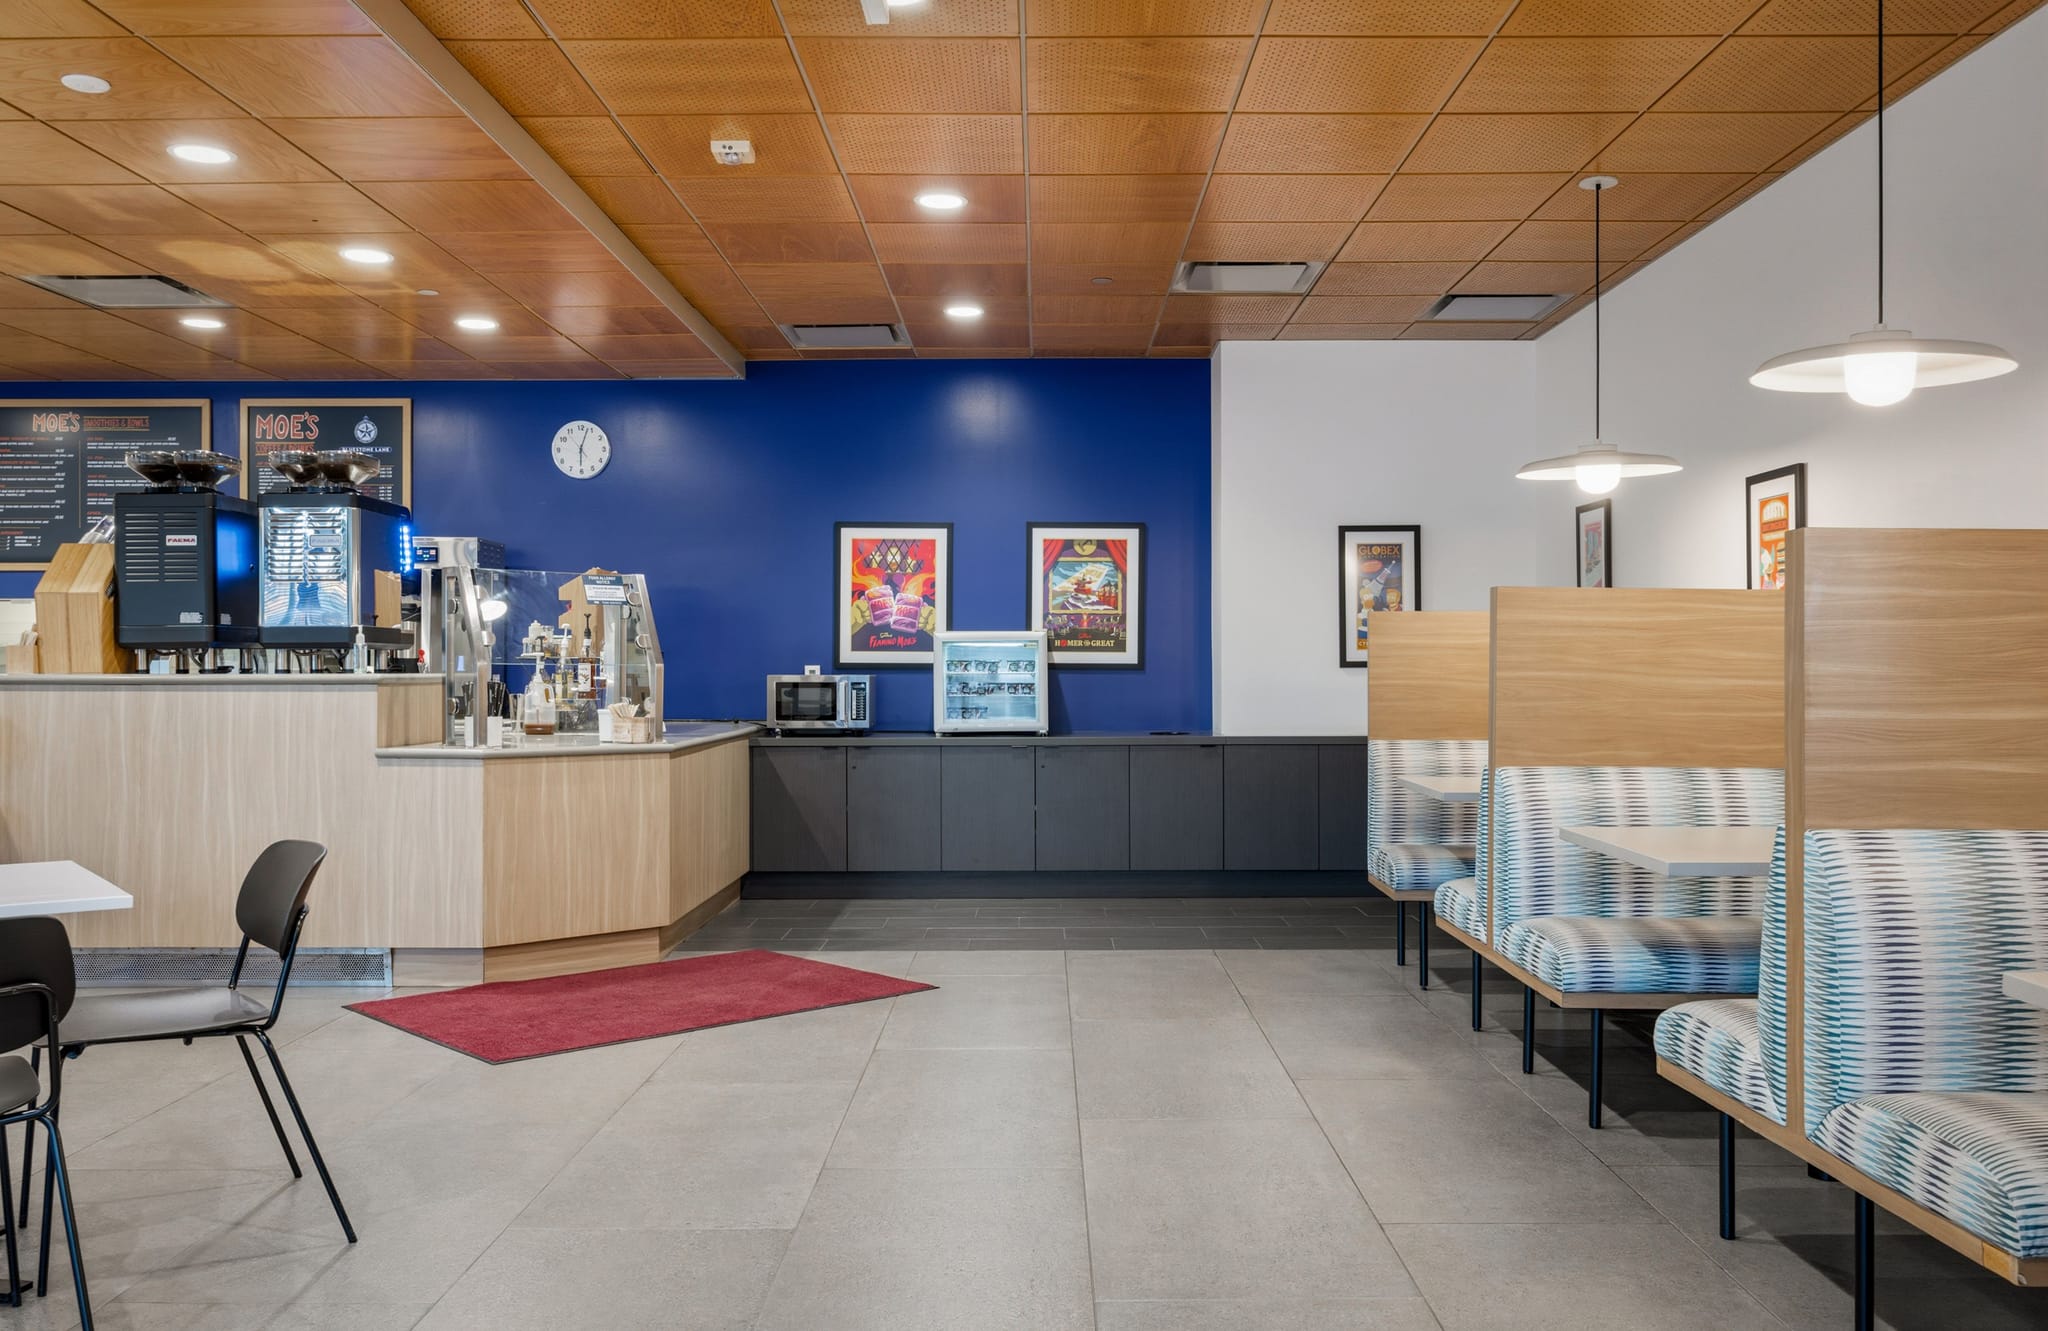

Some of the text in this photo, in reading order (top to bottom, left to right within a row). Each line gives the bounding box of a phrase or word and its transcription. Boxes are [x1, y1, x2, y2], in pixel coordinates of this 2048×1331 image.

[33, 412, 150, 433] MOE'S SMOOTHIES & BOWLS
[256, 412, 319, 439] MOE'S
[1359, 546, 1400, 555] GLOBEX
[1054, 639, 1083, 648] HOMER
[1091, 639, 1115, 648] GREAT
